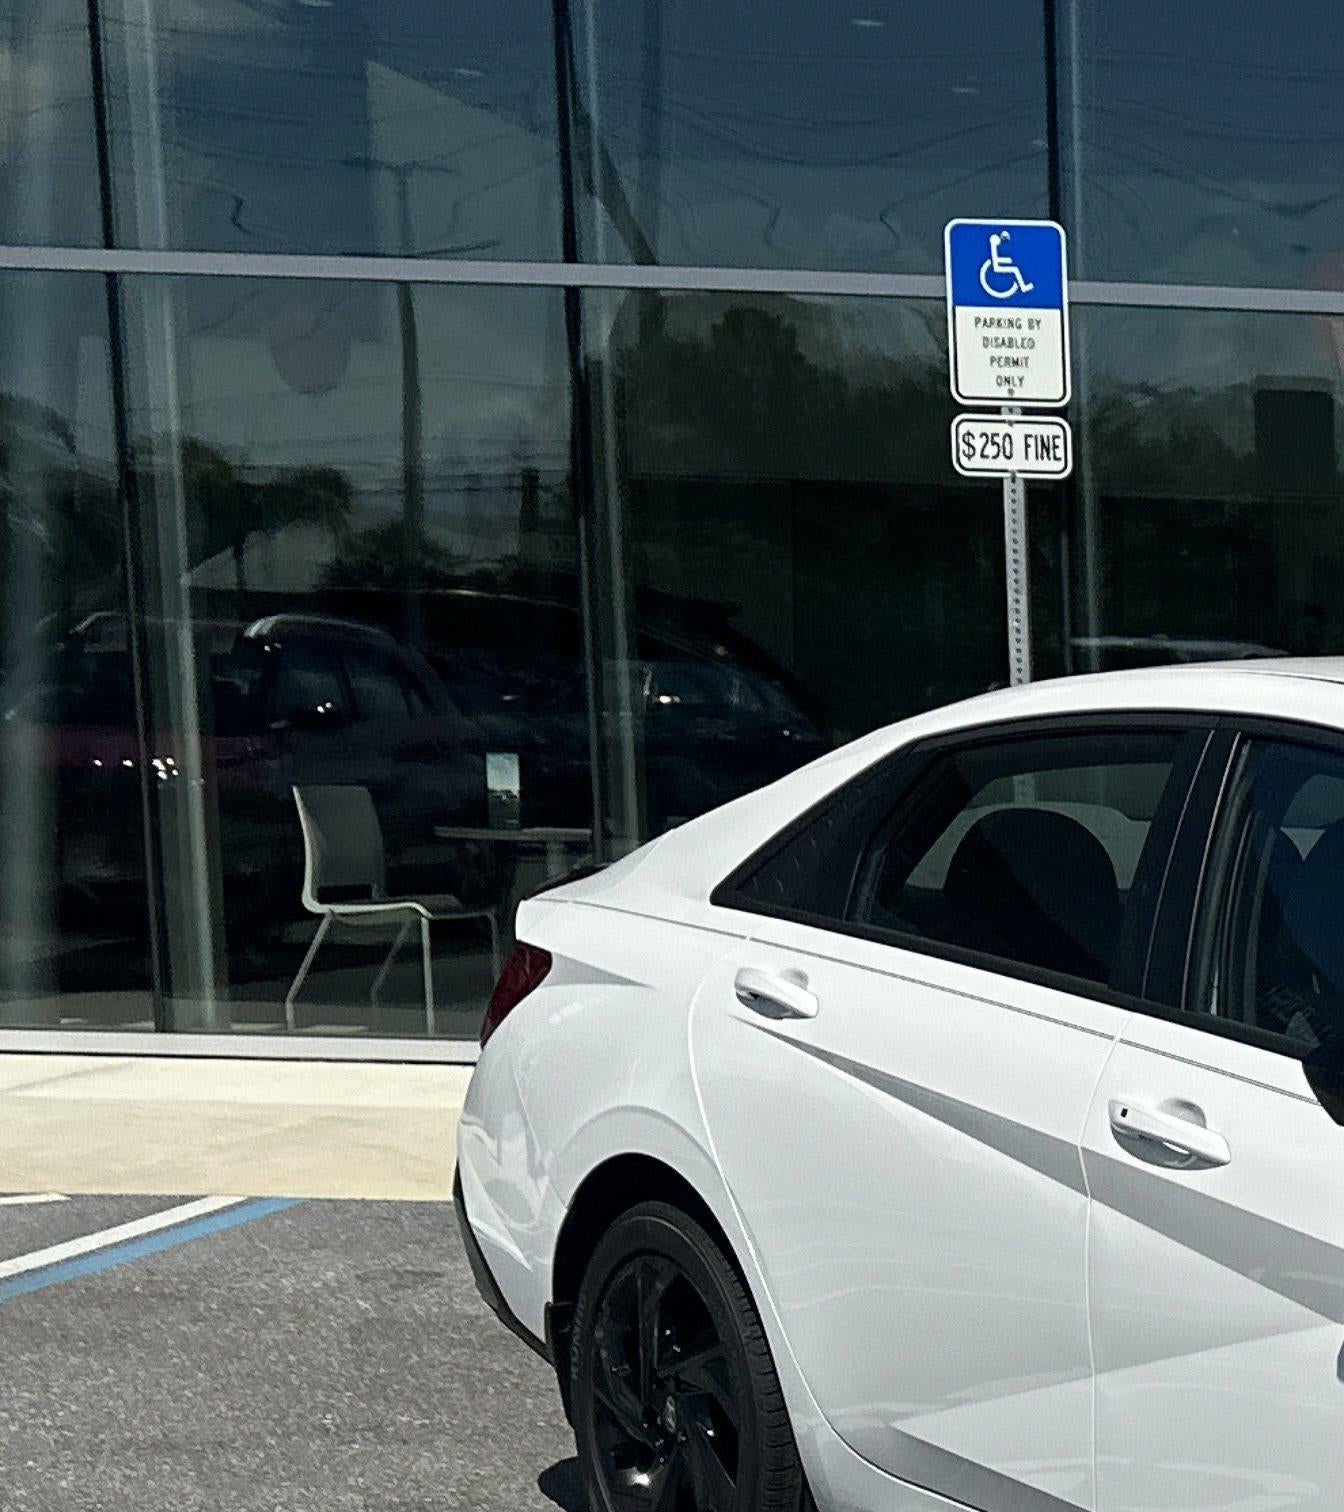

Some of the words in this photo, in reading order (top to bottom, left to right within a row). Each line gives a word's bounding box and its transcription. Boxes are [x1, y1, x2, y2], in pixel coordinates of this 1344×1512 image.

[974, 316, 1022, 330] PARKING
[1027, 318, 1041, 330] BY
[982, 336, 1035, 349] DISABLED
[990, 355, 1030, 368] PERMIT
[996, 375, 1025, 388] ONLY
[961, 430, 1014, 461] $250
[1024, 434, 1062, 461] FINE
